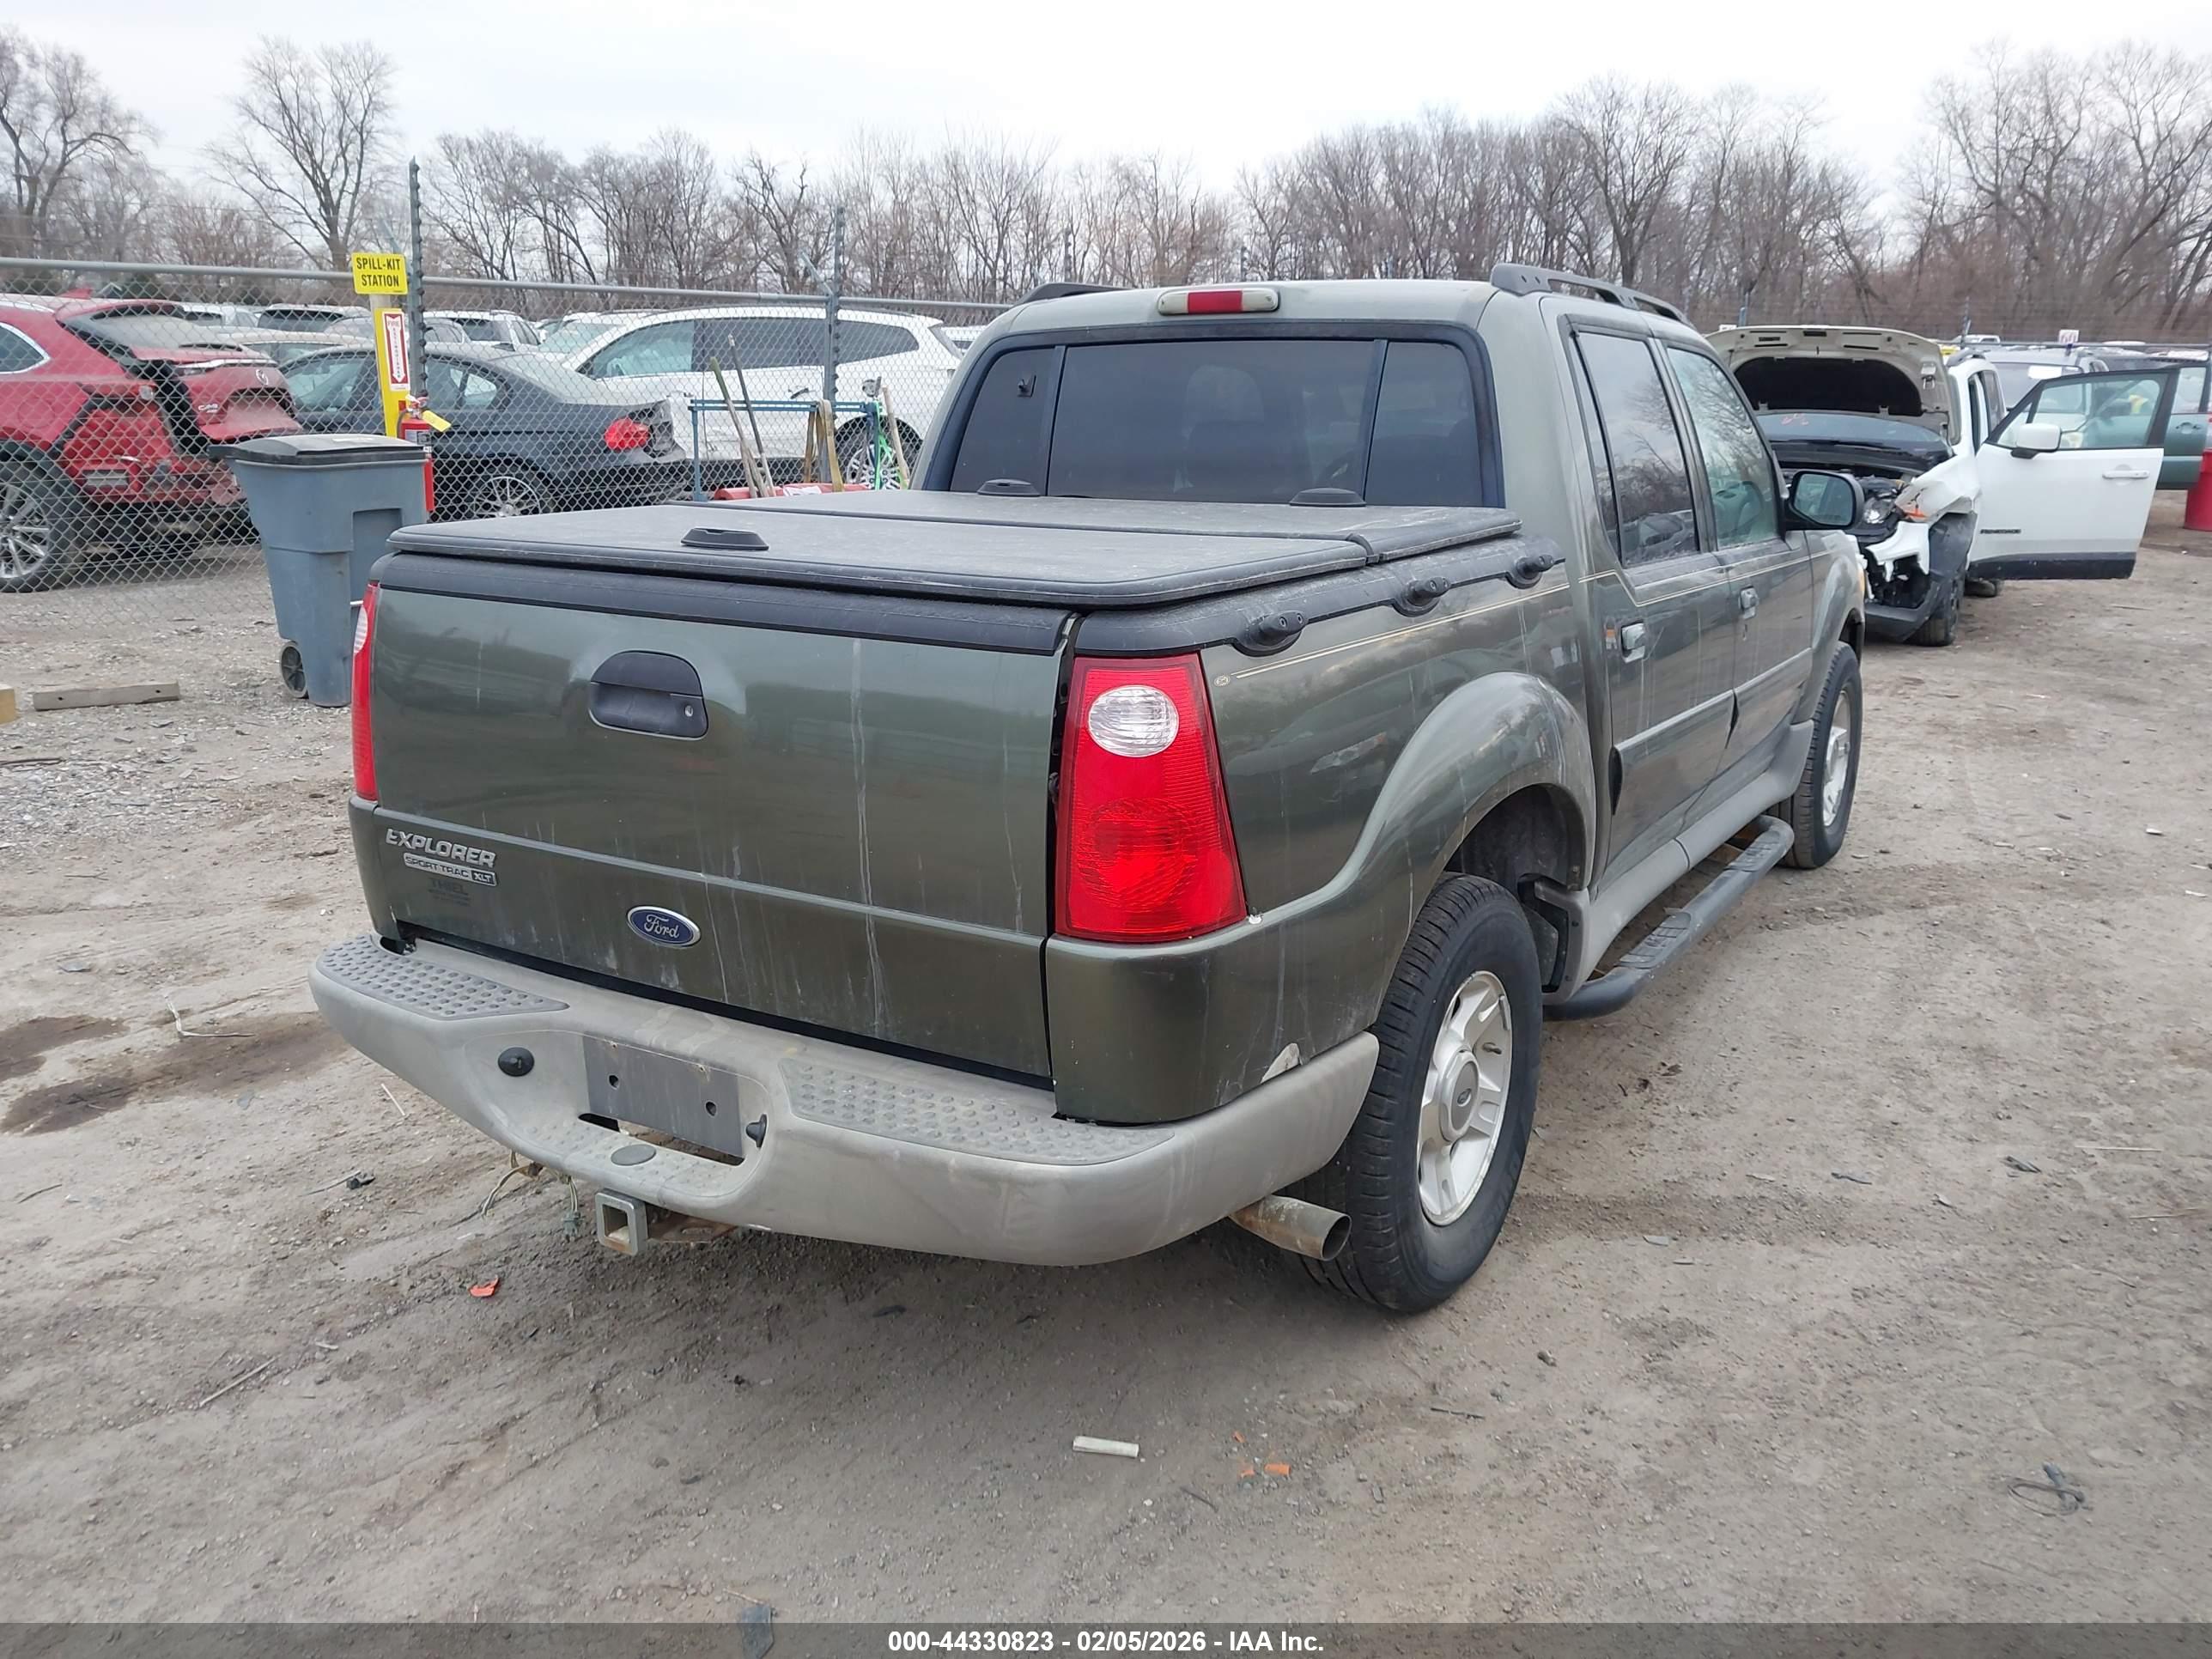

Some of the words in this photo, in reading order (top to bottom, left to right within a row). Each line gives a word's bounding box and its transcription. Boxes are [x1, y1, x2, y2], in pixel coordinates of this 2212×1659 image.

[356, 257, 400, 270] SPILL-KIT
[362, 274, 399, 287] STATION
[386, 828, 496, 868] EXPLORER
[404, 856, 439, 872] SPORT
[439, 865, 470, 878] TRAC
[473, 872, 492, 883] XLT
[644, 914, 679, 939] Ford
